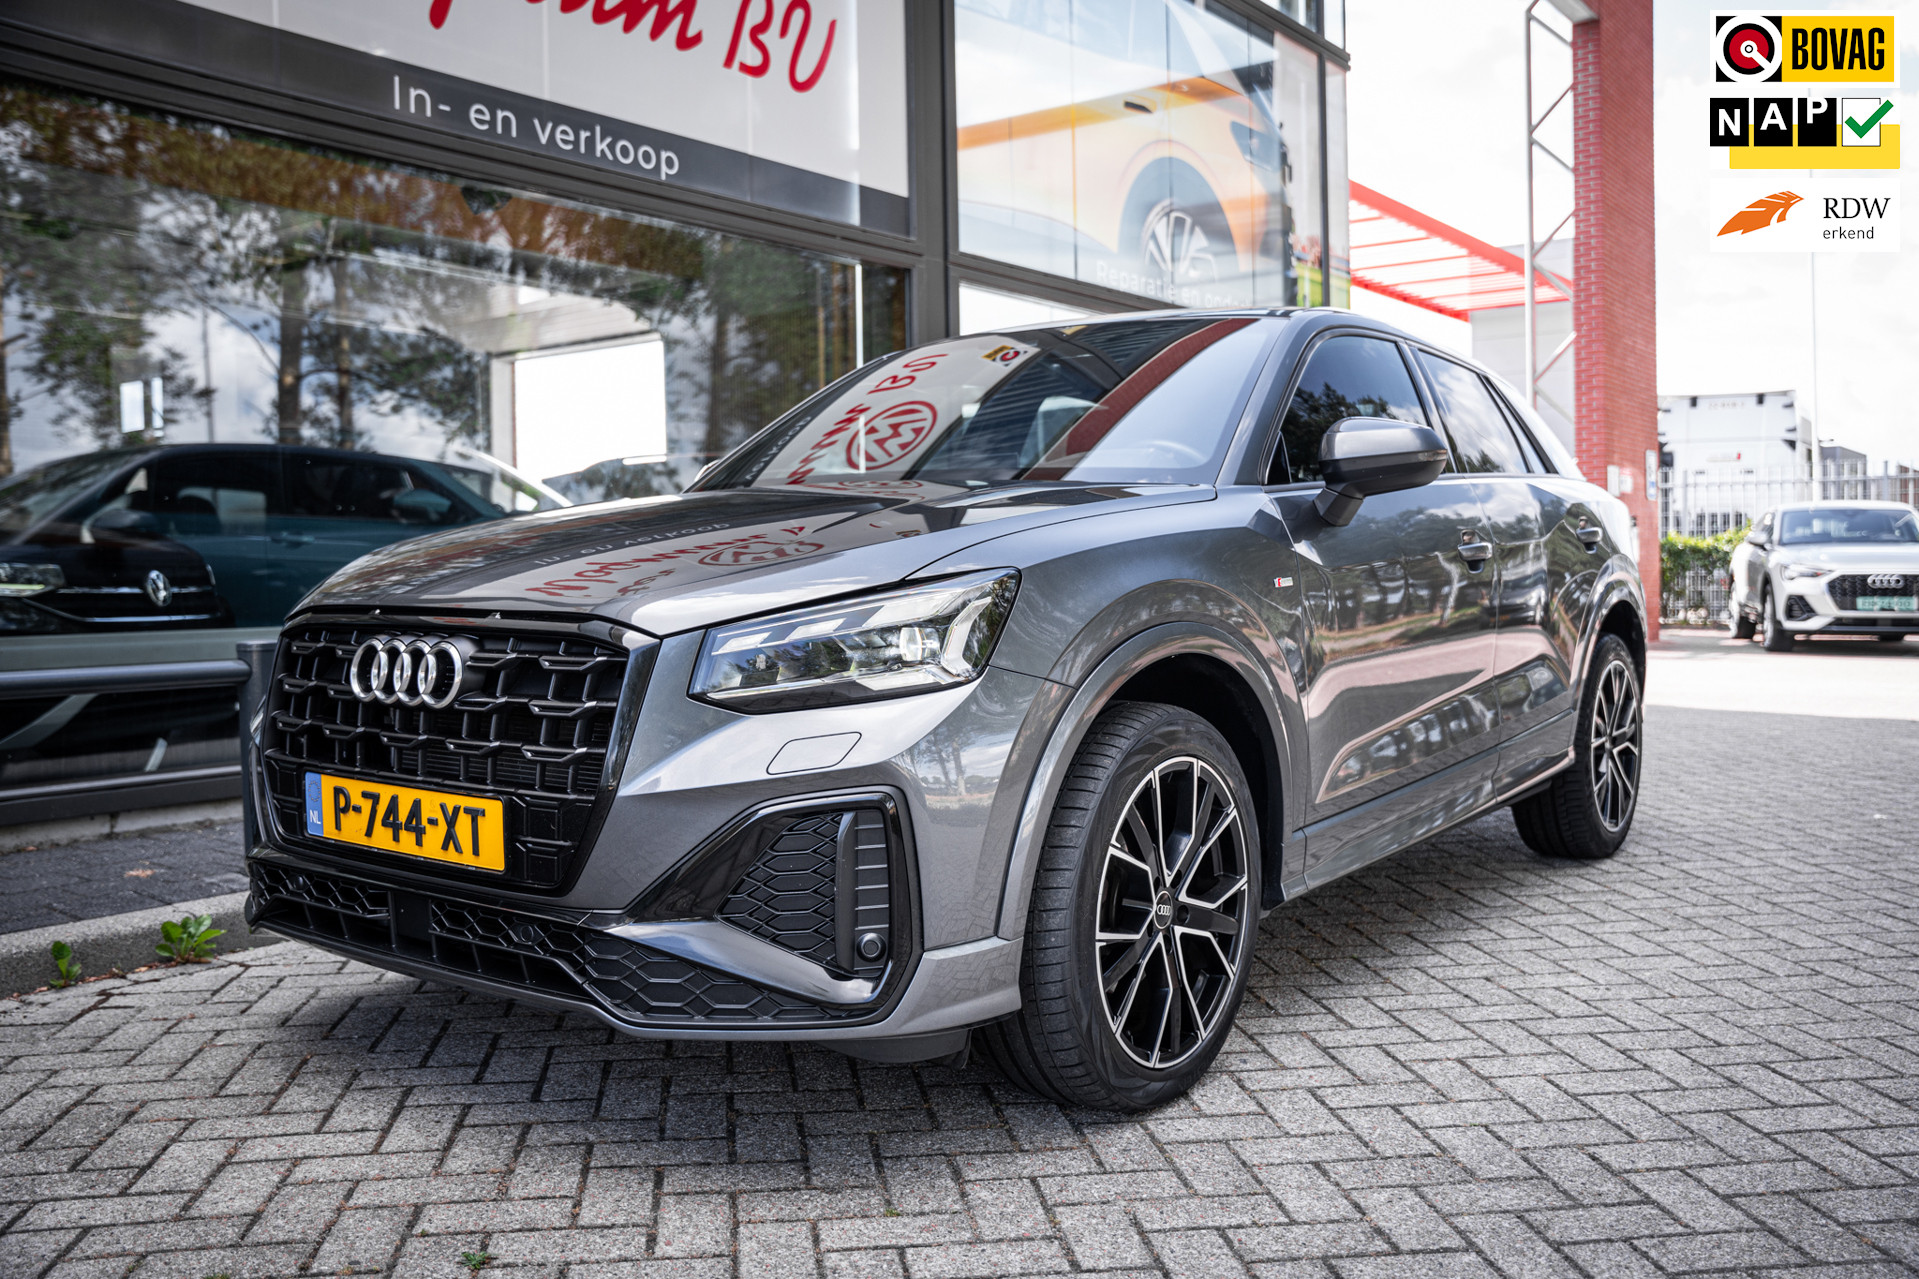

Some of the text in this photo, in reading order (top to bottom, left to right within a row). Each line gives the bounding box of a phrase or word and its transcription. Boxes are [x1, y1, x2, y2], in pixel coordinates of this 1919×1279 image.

[393, 75, 680, 181] In- en verkoop
[1096, 261, 1177, 300] Reparatie
[1182, 288, 1200, 305] en
[309, 809, 322, 825] NL
[333, 785, 486, 857] P-744-XT
